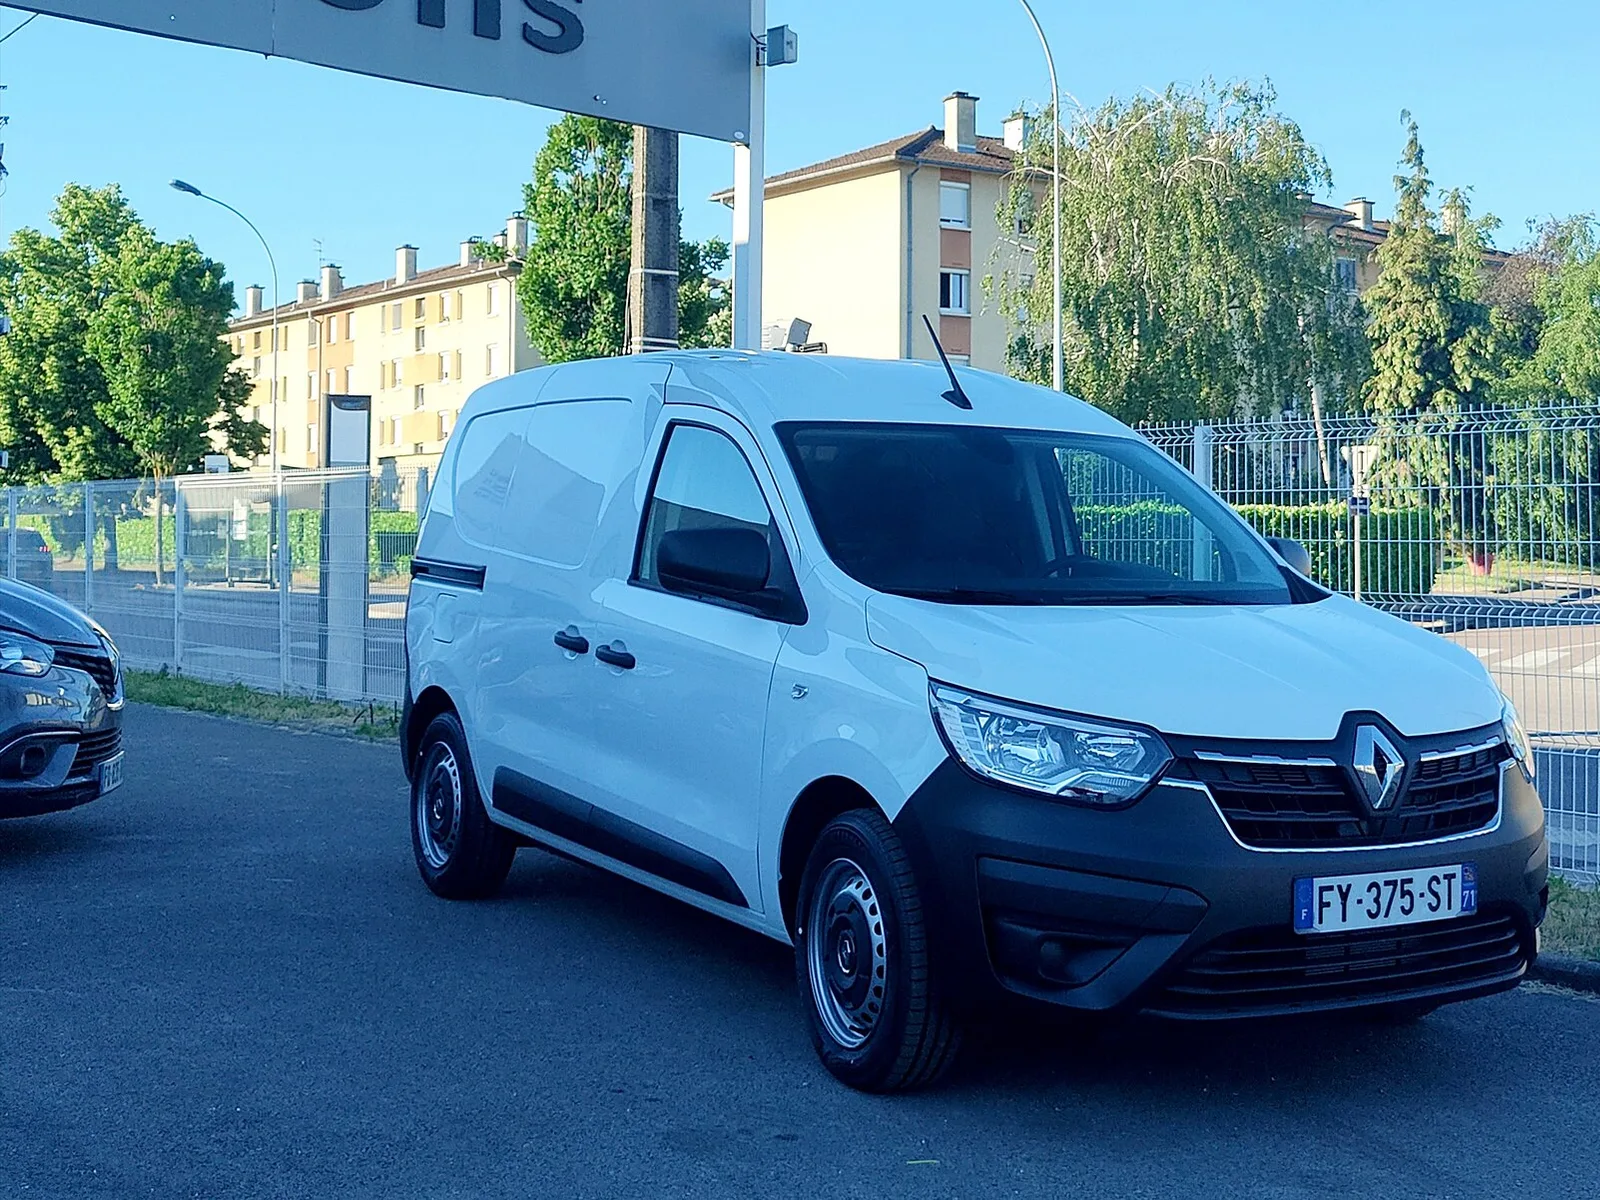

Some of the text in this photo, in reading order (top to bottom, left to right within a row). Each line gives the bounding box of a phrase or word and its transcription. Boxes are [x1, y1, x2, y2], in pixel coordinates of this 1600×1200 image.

[1318, 873, 1456, 925] FY-375-ST
[1463, 890, 1474, 907] 71
[1302, 909, 1308, 920] F
